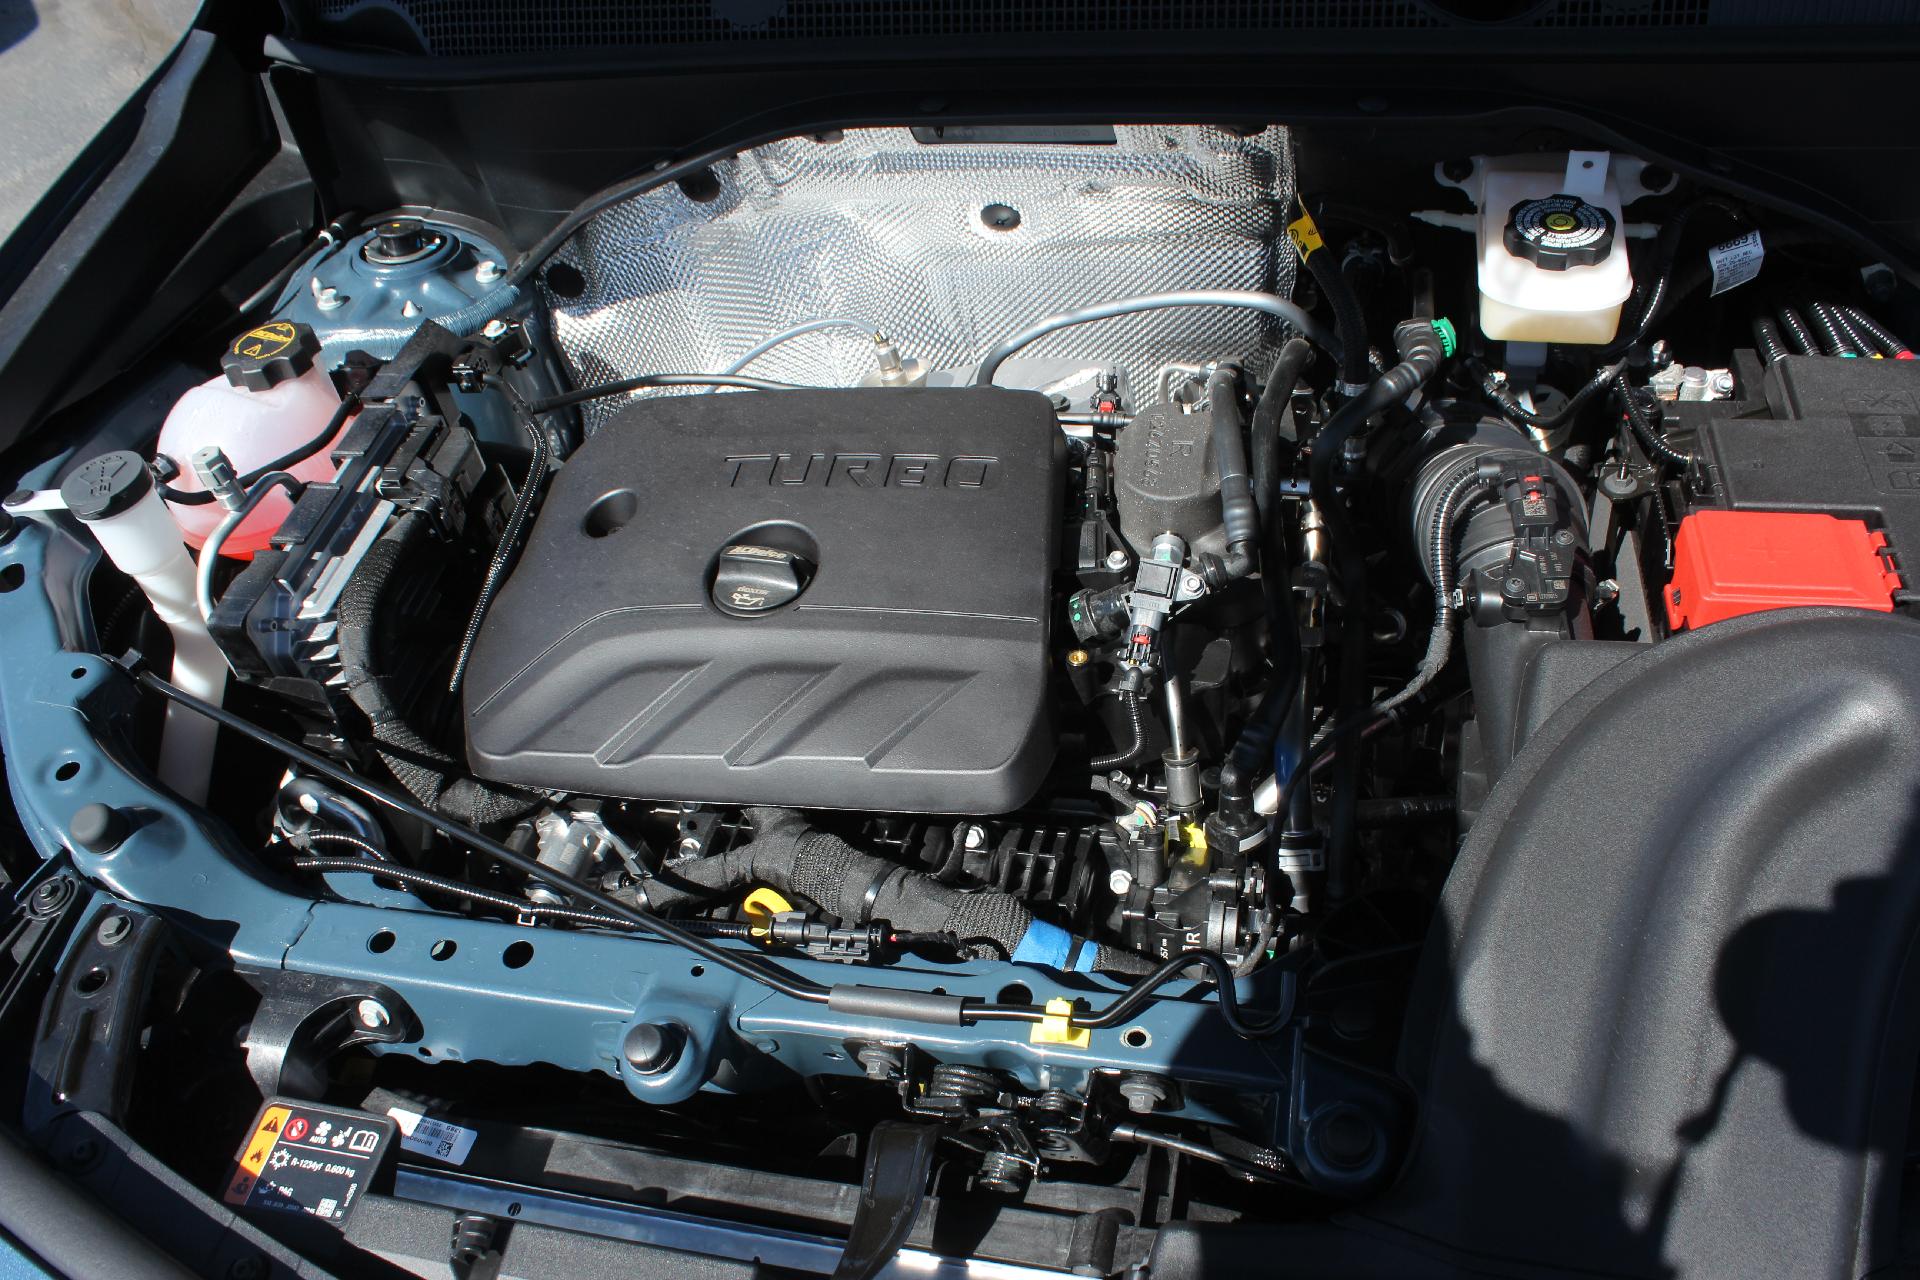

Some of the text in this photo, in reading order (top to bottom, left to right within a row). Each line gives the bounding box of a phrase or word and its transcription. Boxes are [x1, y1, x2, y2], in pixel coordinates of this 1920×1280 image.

[724, 452, 1000, 488] TURBO
[309, 1135, 327, 1145] AUTO
[290, 1157, 356, 1178] R-1234yf 0.600 kg
